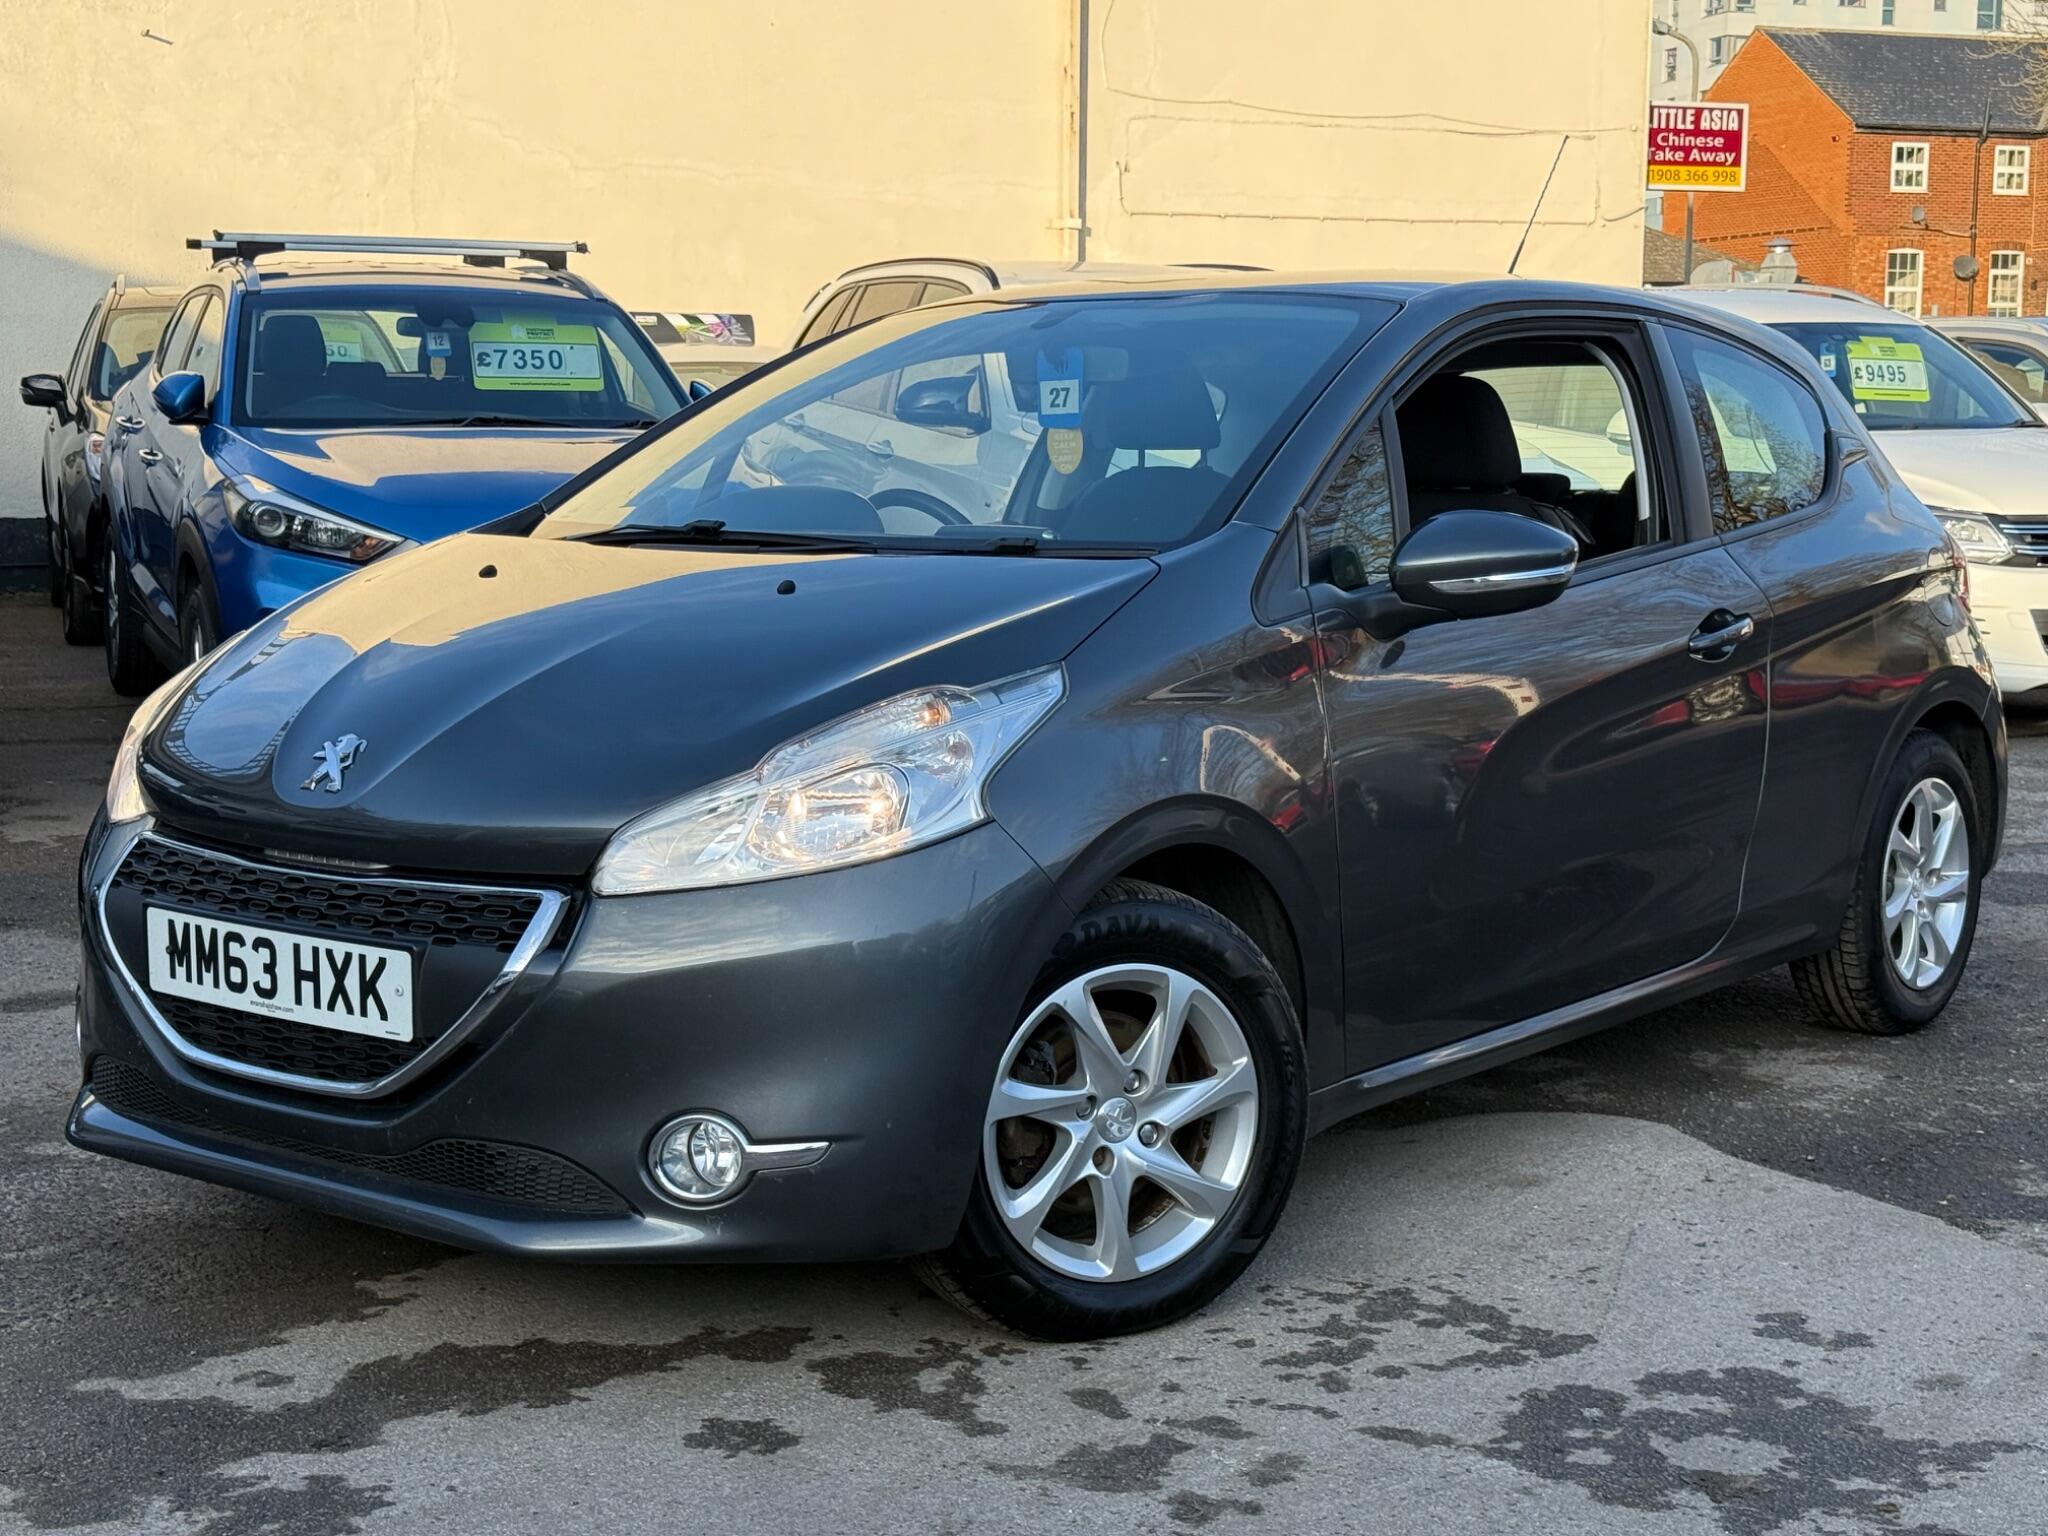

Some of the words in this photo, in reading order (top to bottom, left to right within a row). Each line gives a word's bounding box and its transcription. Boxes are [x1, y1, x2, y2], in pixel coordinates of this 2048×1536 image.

[1649, 107, 1695, 129] ITTLE
[1700, 109, 1739, 131] ASIA
[1656, 132, 1725, 147] Chinese
[1688, 148, 1736, 166] Away
[1685, 169, 1709, 182] 366
[1712, 170, 1737, 183] 998
[432, 335, 444, 347] 12
[476, 348, 563, 370] £7350
[1854, 364, 1906, 383] £9495
[1049, 387, 1071, 408] 27
[167, 918, 278, 1000] MM63
[292, 942, 389, 1022] HXK
